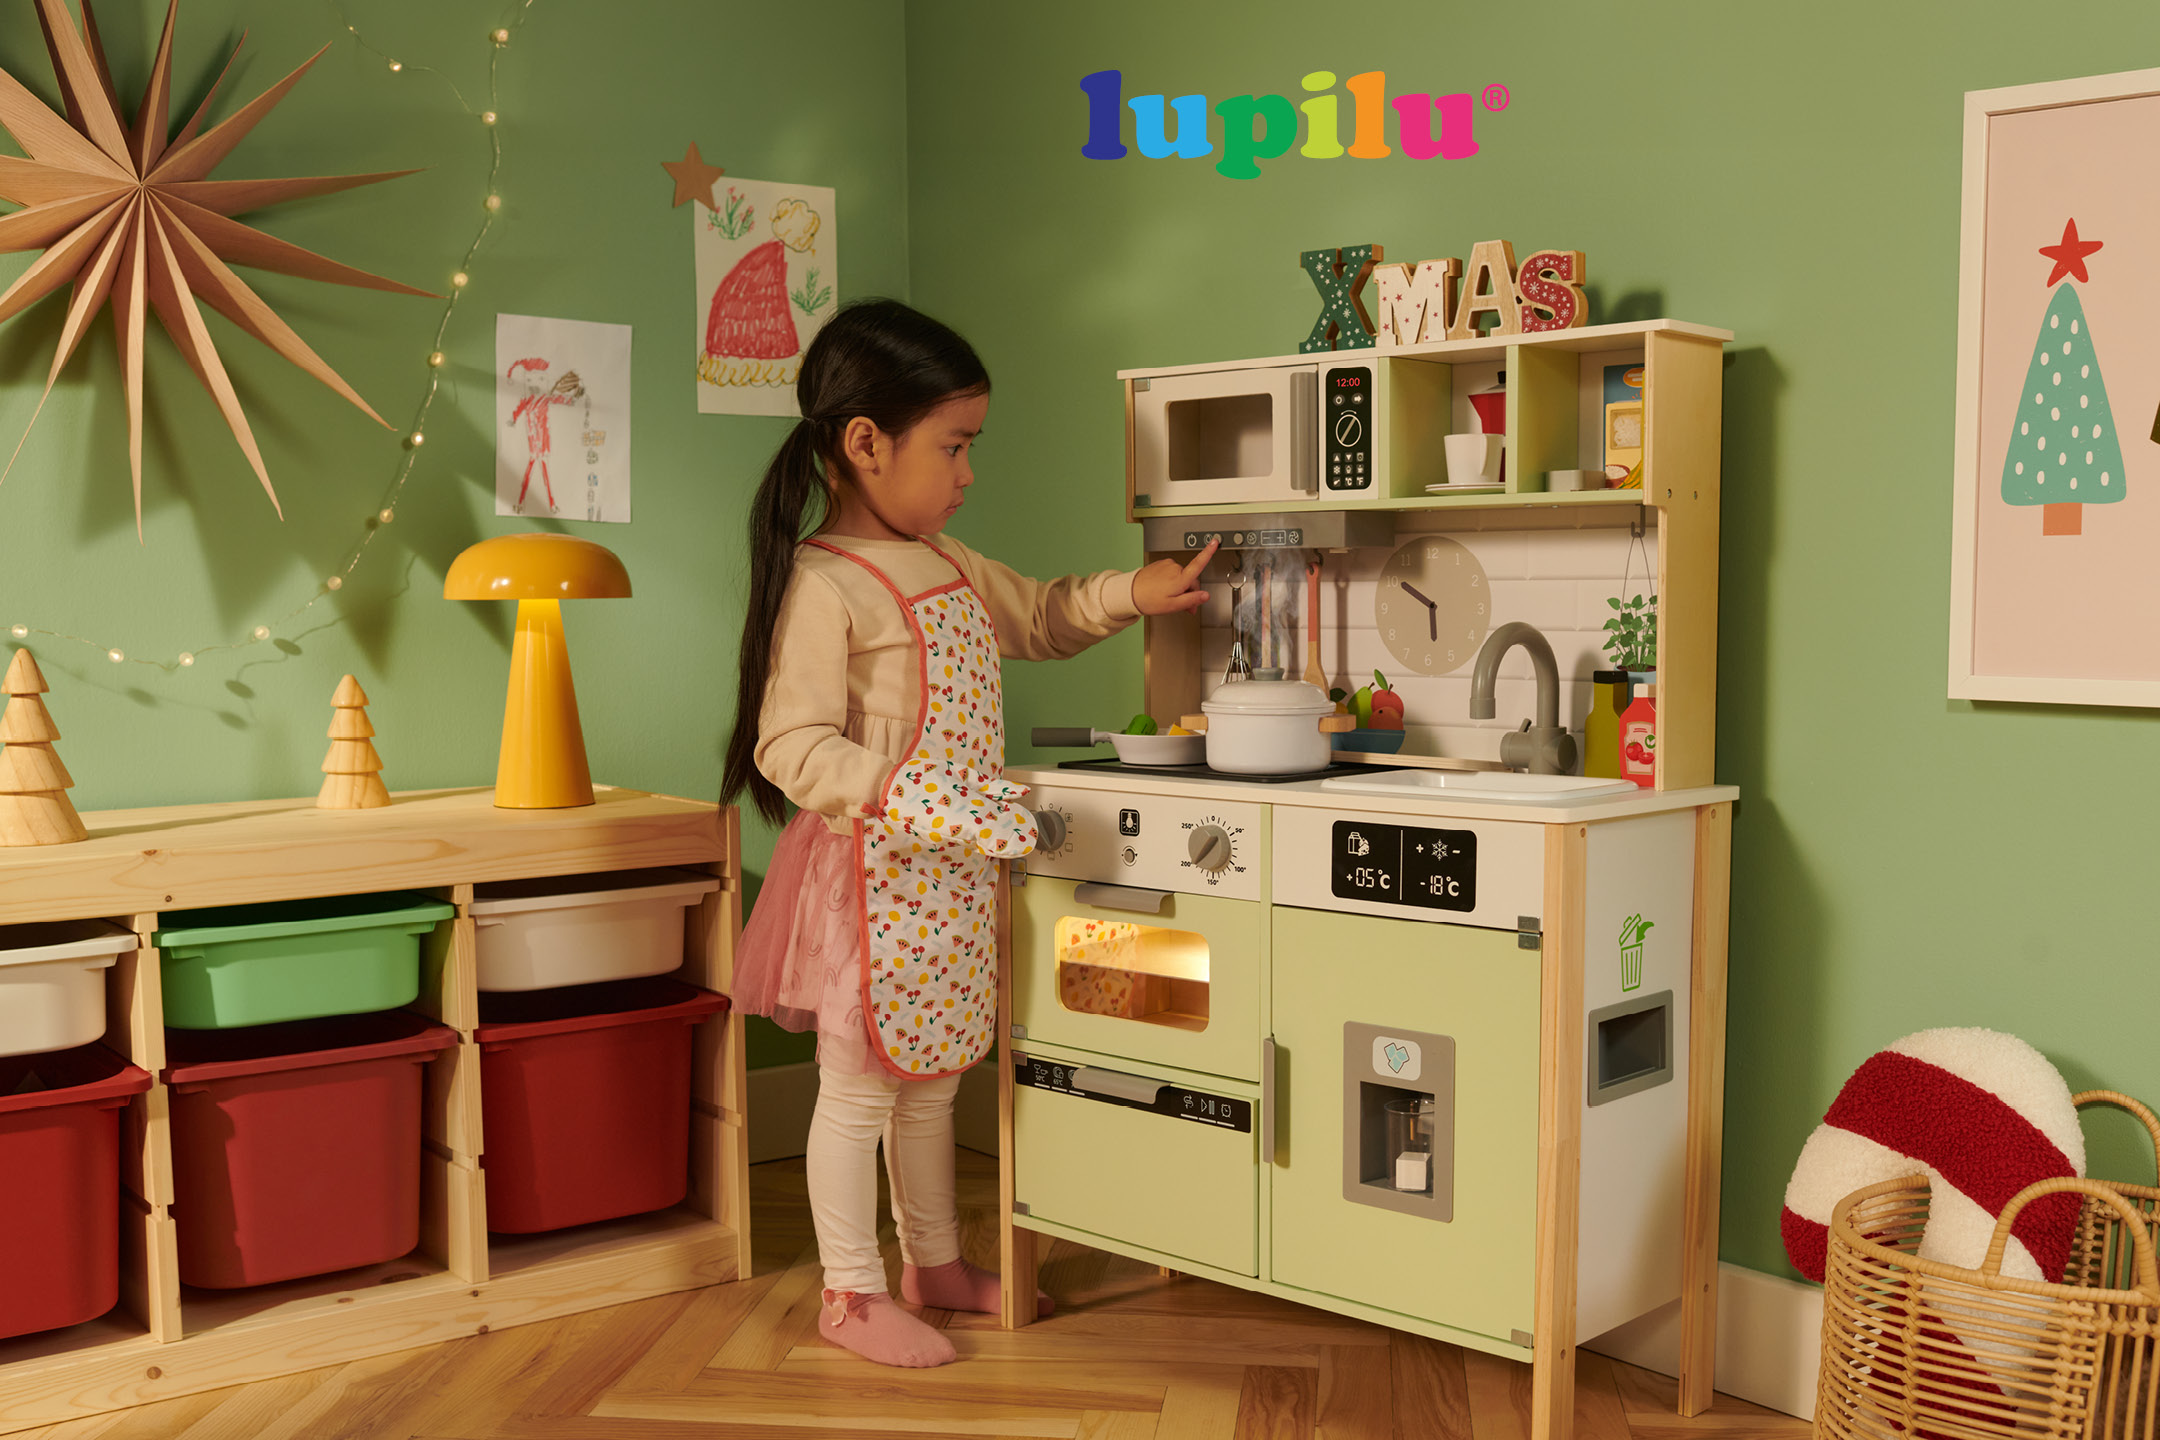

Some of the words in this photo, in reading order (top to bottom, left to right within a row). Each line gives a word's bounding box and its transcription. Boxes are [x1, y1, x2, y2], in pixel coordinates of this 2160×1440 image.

[1299, 239, 1588, 354] XMAS
[1336, 377, 1361, 388] 12:00
[1426, 547, 1439, 559] 12
[1400, 554, 1411, 567] 11
[1455, 553, 1460, 566] 1
[1386, 575, 1399, 587] 10
[1471, 574, 1479, 587] 2
[1381, 602, 1388, 615] 9
[1477, 602, 1485, 615] 3
[1388, 628, 1396, 641] 8
[1467, 630, 1475, 641] 4
[1403, 648, 1410, 660] 7
[1424, 654, 1432, 666] 6
[1447, 650, 1455, 662] 5
